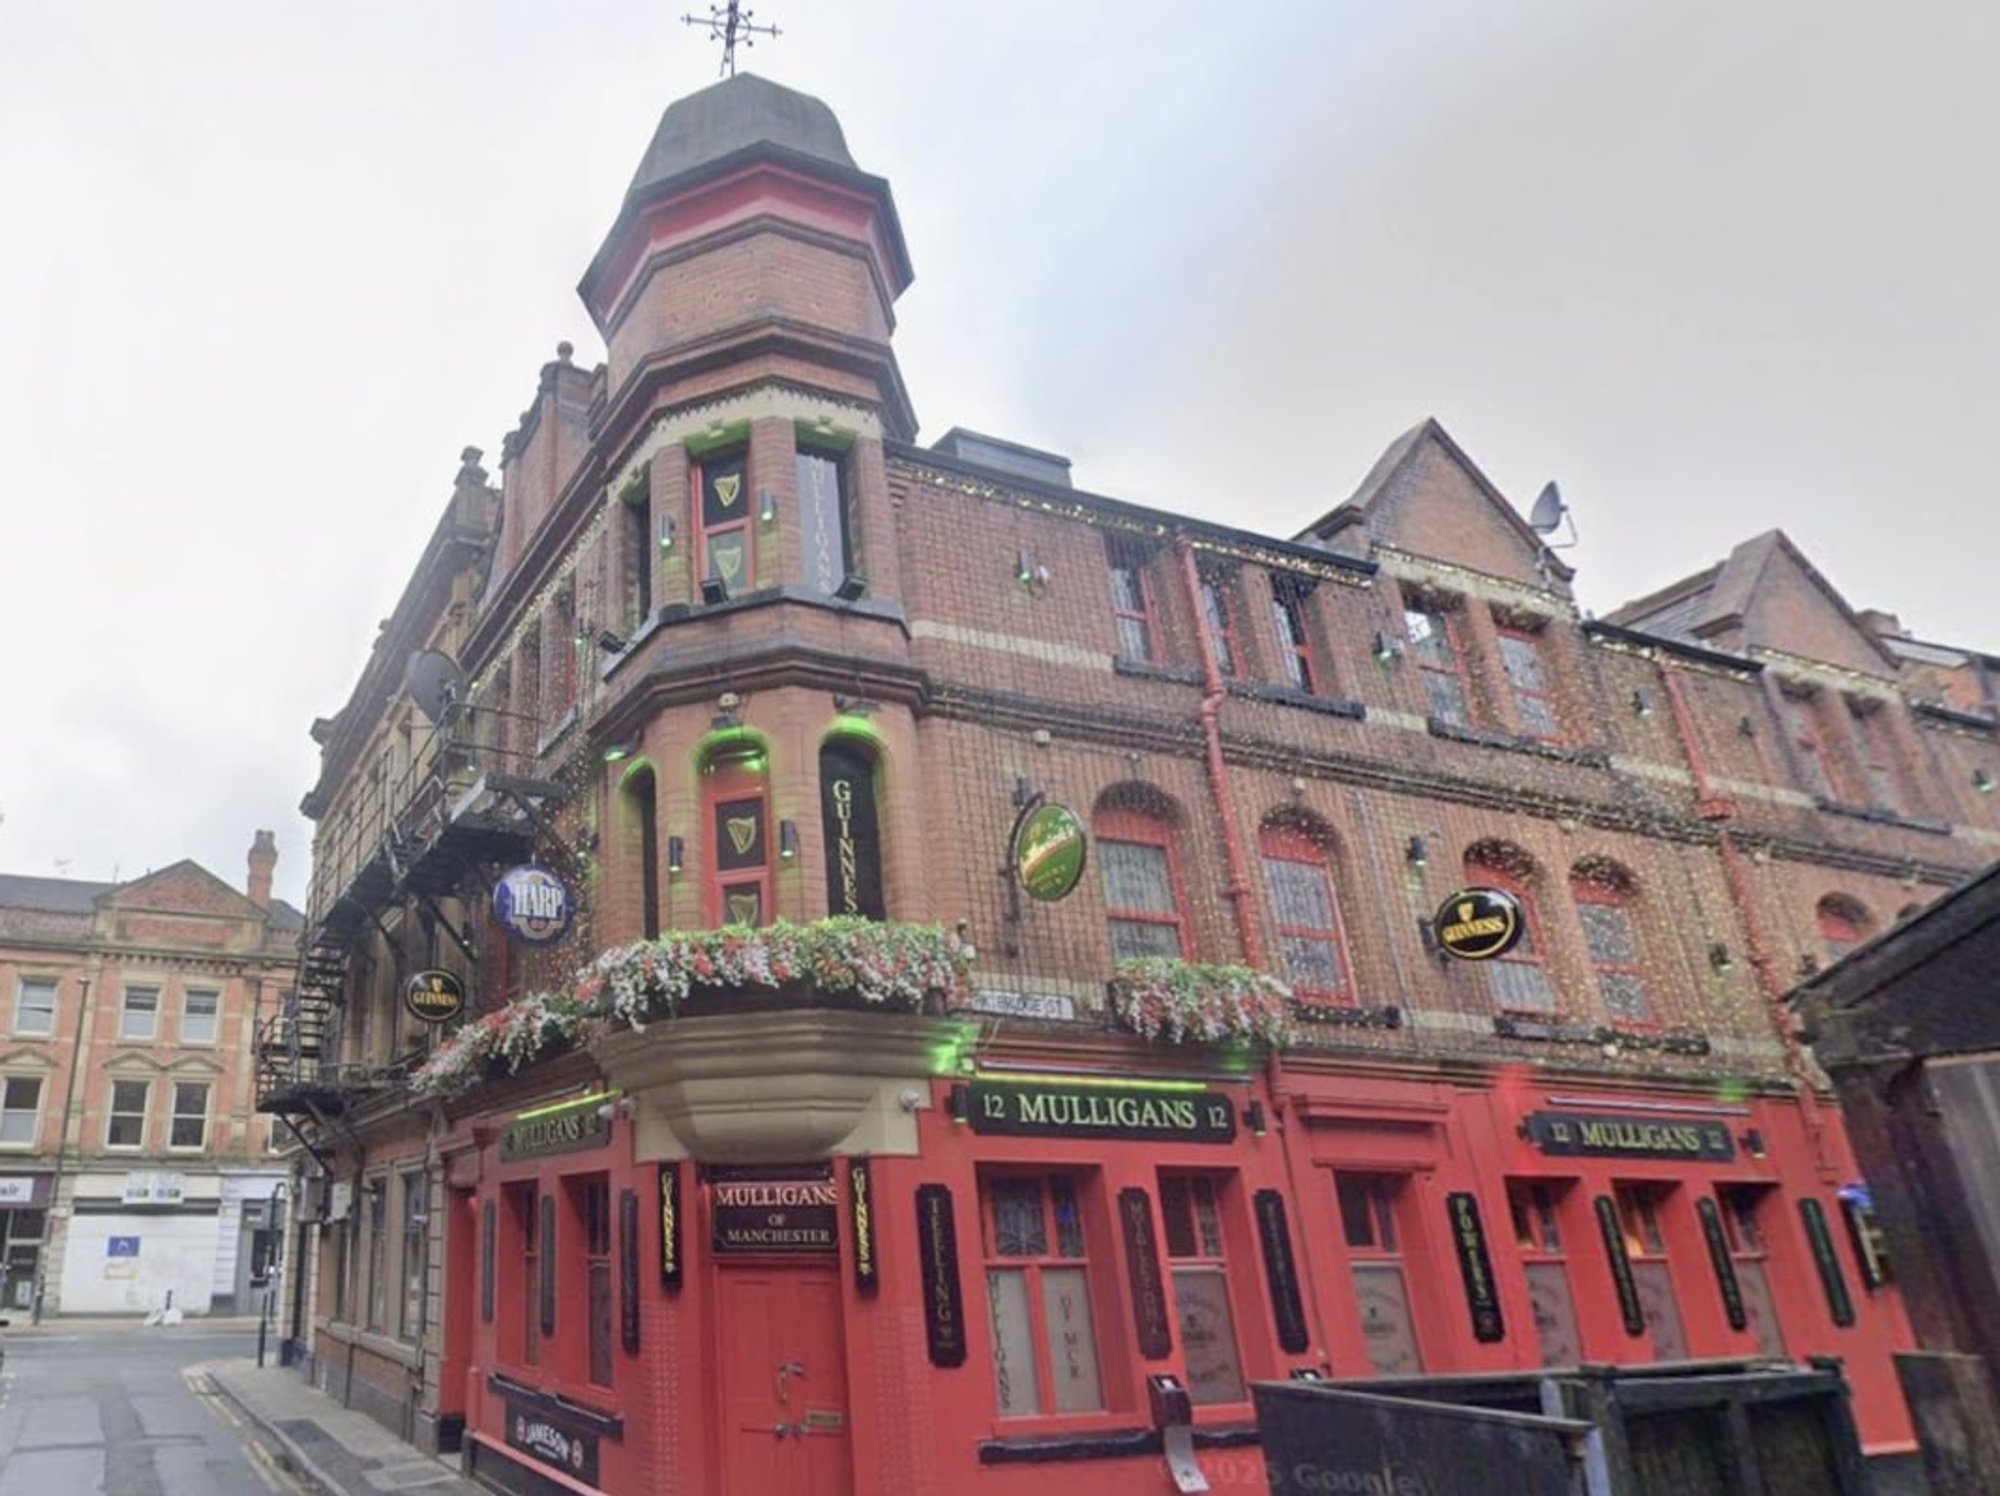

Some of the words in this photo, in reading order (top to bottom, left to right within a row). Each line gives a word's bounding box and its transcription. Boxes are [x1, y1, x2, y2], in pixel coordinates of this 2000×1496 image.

[832, 779, 858, 913] GUINNES
[513, 884, 562, 919] HARP
[1442, 916, 1506, 944] GUINNESS
[983, 1093, 1005, 1118] 12
[1017, 1092, 1197, 1130] MULLIGANS
[1208, 1106, 1228, 1128] 12
[1579, 1121, 1701, 1151] MULLIGANS
[716, 1186, 838, 1206] MULLIGANS
[768, 1213, 787, 1226] OF
[726, 1228, 832, 1243] MANCHESTER
[525, 1423, 569, 1462] JAMESON
